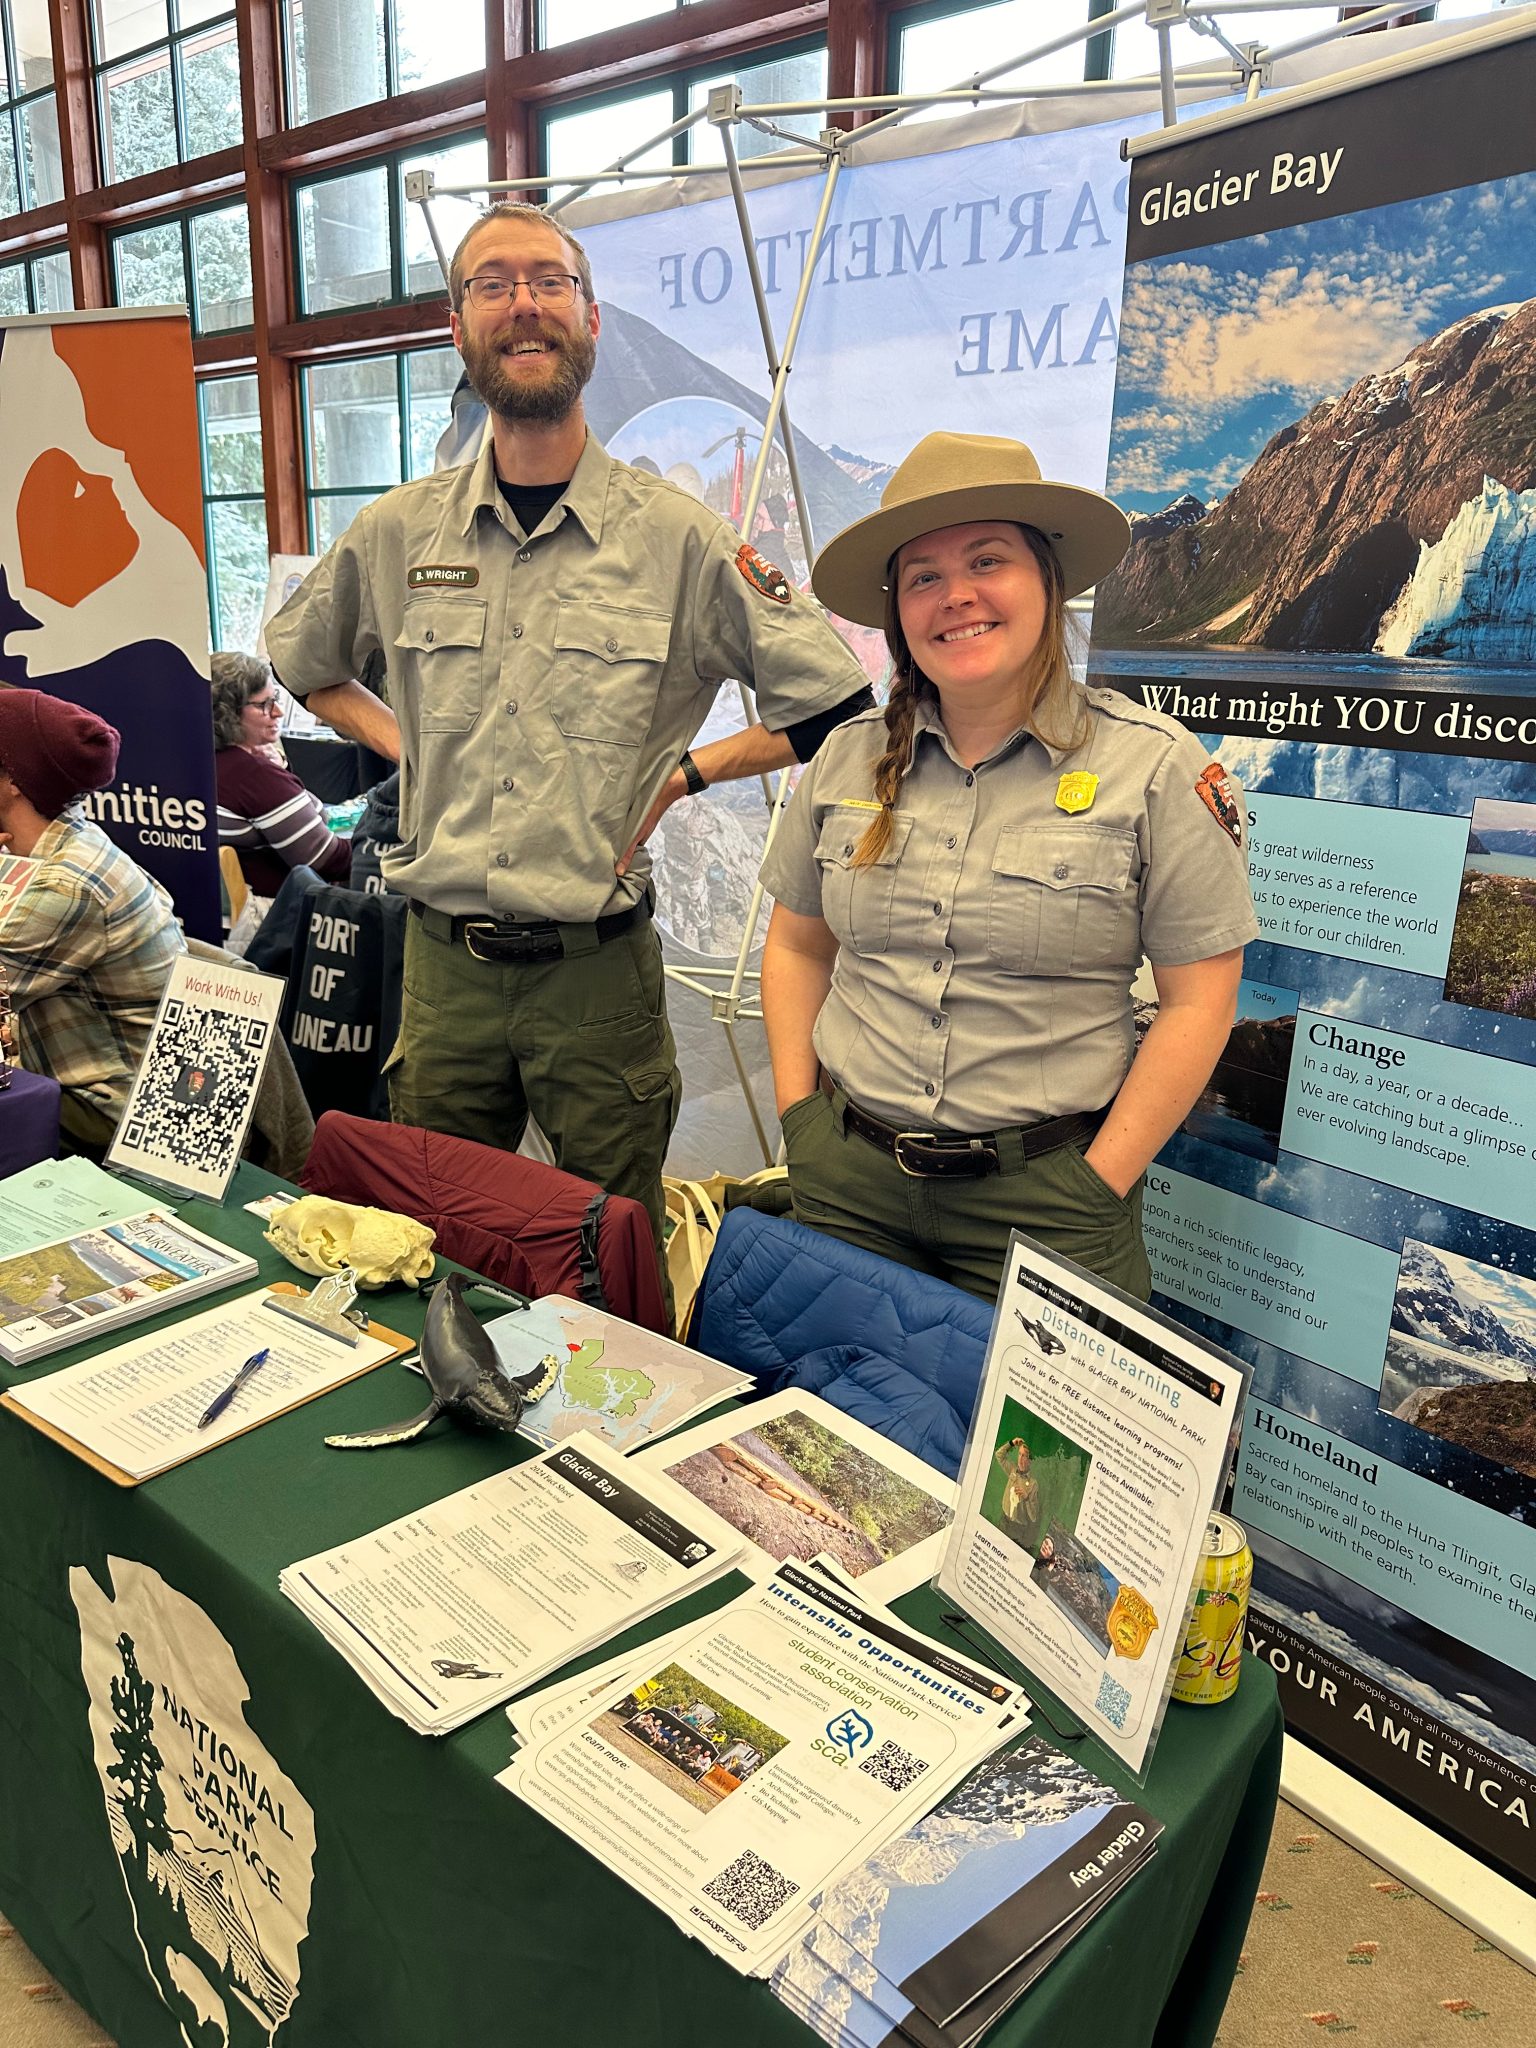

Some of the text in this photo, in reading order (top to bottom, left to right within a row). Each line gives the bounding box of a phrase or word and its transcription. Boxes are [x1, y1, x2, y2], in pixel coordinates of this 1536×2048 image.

[1140, 147, 1344, 226] Glacier Bay
[416, 570, 467, 580] B. WRIGHT
[1140, 684, 1536, 745] What might YOU disco
[139, 829, 207, 851] COUNCIL
[1264, 843, 1374, 871] great wilderness
[1249, 862, 1418, 904] Bay serves as a reference
[310, 912, 360, 956] PORT
[1253, 891, 1438, 935] us to experience the world
[1281, 920, 1405, 956] it for our children.
[185, 976, 263, 1007] Work With Us!
[310, 964, 345, 1001] OF
[1251, 989, 1277, 1005] Today
[292, 1010, 373, 1053] UNEAU
[1309, 1023, 1406, 1070] Change
[1300, 1079, 1526, 1157] We are catching but a glimpse
[1304, 1055, 1523, 1127] In a day, a year, or a decade...
[1297, 1106, 1470, 1168] ever evolving landscape.
[135, 1229, 216, 1276] FAIRWEATHER
[1143, 1202, 1305, 1278] upon a rich scientific legacy,
[1020, 1272, 1083, 1314] Glacier Bay National Park
[1148, 1246, 1328, 1331] at work in Glacier Bay and our
[1187, 1285, 1223, 1310] world.
[1197, 1246, 1315, 1303] seek to understand
[1042, 1306, 1105, 1358] Distance
[1110, 1347, 1181, 1408] Learning
[1021, 1357, 1183, 1470] Join us for FREE distance learning programs!
[1088, 1365, 1207, 1446] GLACIER BAY NATIONAL PARK!
[559, 1453, 620, 1498] Glacier Bay
[1253, 1408, 1378, 1486] Homeland
[530, 1465, 574, 1498] 2024 Fact Sheet
[1096, 1461, 1155, 1508] Classes Available:
[1242, 1485, 1416, 1586] relationship with the earth.
[1245, 1462, 1503, 1605] Bay can inspire all peoples to examine
[1248, 1442, 1502, 1582] Sacred homeland to the Huna Tlingit,
[784, 1569, 862, 1621] Glacier Bay National Park
[759, 1598, 776, 1611] How
[783, 1615, 801, 1627] gain
[801, 1625, 841, 1651] experience
[841, 1648, 859, 1662] with
[858, 1659, 872, 1669] the
[872, 1666, 908, 1690] National
[906, 1686, 926, 1701] Park
[926, 1698, 962, 1721] Service?
[767, 1582, 985, 1714] Internship Opportunities
[788, 1639, 921, 1721] student conservation
[799, 1663, 872, 1710] association
[1249, 1614, 1527, 1787] saved by the American people so that all may experience
[810, 1738, 848, 1766] sca
[1248, 1631, 1337, 1706] YOUR
[1353, 1703, 1530, 1828] AMERICA
[161, 1683, 294, 1841] NATIONAL
[193, 1752, 259, 1841] PARK
[1069, 1821, 1145, 1888] Glacier Bay
